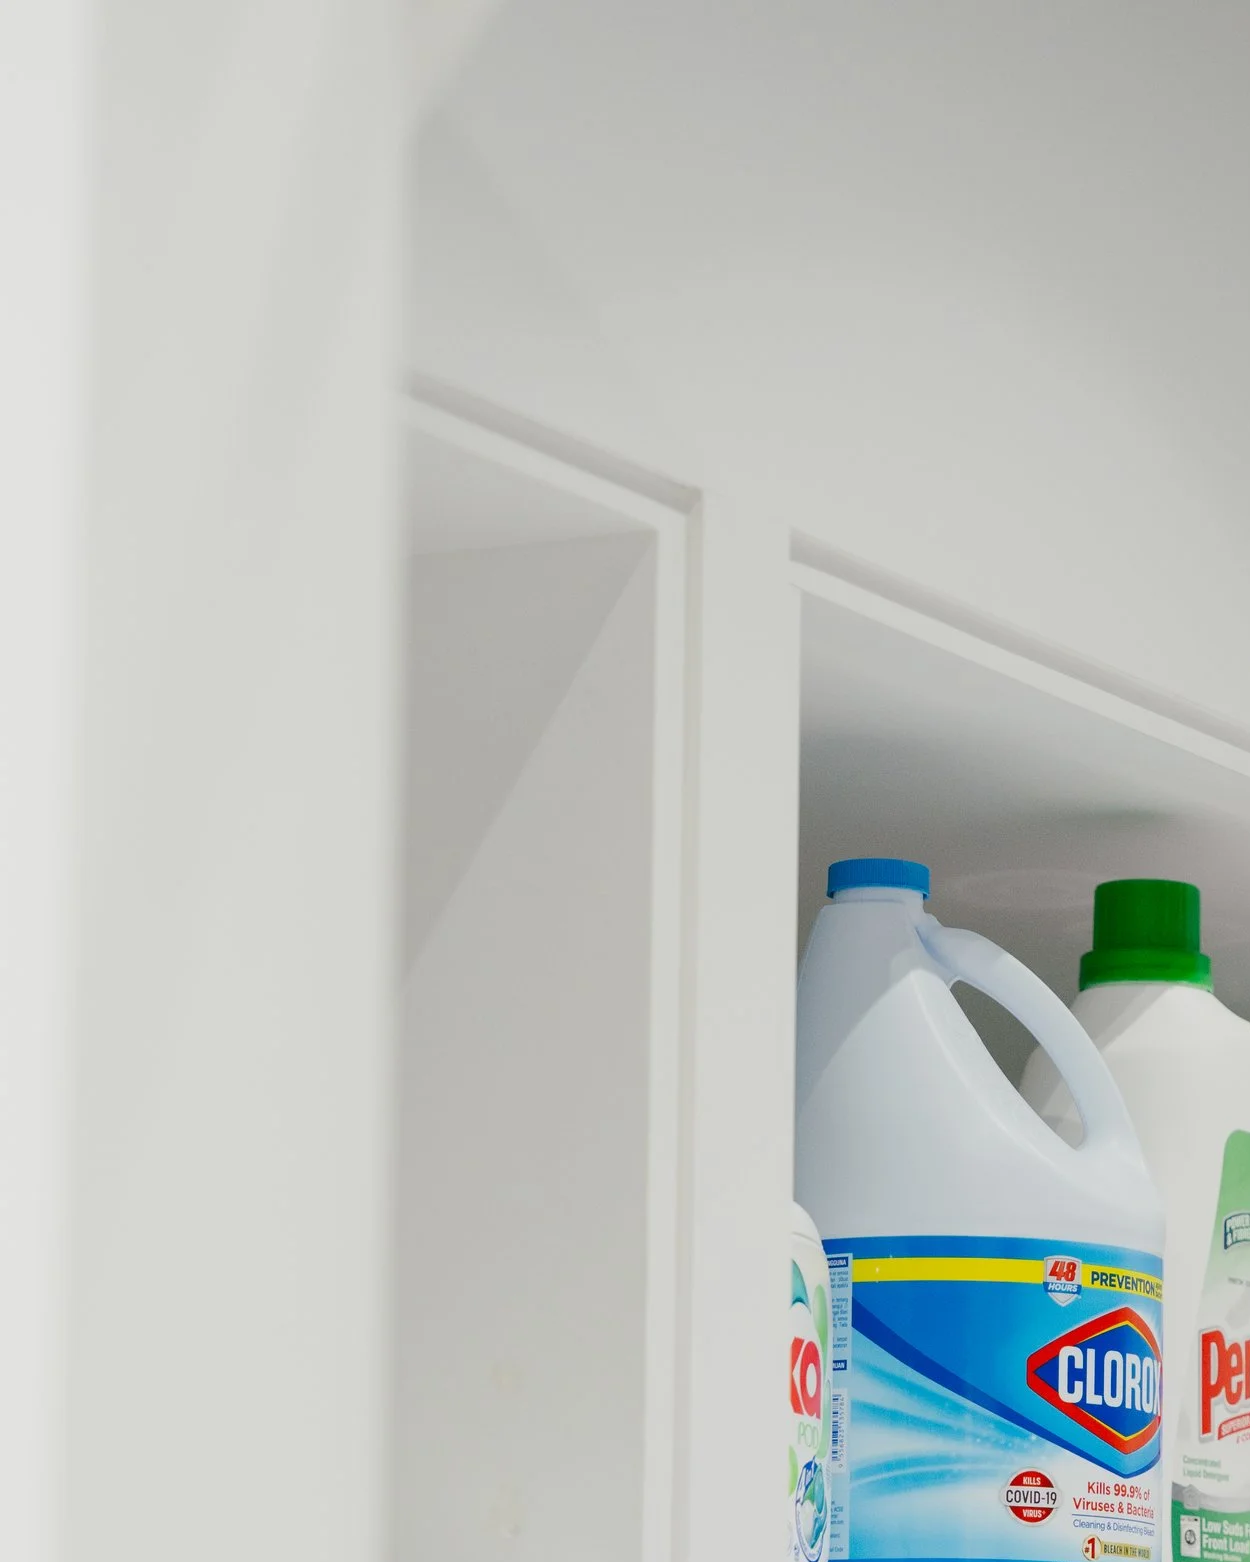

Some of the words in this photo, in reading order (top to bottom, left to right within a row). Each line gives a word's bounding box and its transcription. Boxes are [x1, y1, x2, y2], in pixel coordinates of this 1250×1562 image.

[1049, 1260, 1077, 1282] 48
[1047, 1281, 1078, 1293] HOURS
[1091, 1270, 1156, 1297] PREVENTION
[1058, 1345, 1161, 1415] CLOROX
[1022, 1476, 1041, 1486] KILLS
[1087, 1481, 1110, 1496] Kills
[1113, 1483, 1142, 1500] 99.9%
[1143, 1488, 1151, 1501] of
[1005, 1489, 1057, 1505] COVID-19
[1073, 1497, 1115, 1513] Viruses
[1117, 1502, 1124, 1514] &
[1126, 1503, 1155, 1519] Bacteria
[1073, 1519, 1105, 1531] Cleaning
[1107, 1522, 1111, 1531] &
[1113, 1523, 1144, 1536] Disinfecting
[1084, 1537, 1096, 1559] #1
[1202, 1533, 1228, 1551] Front
